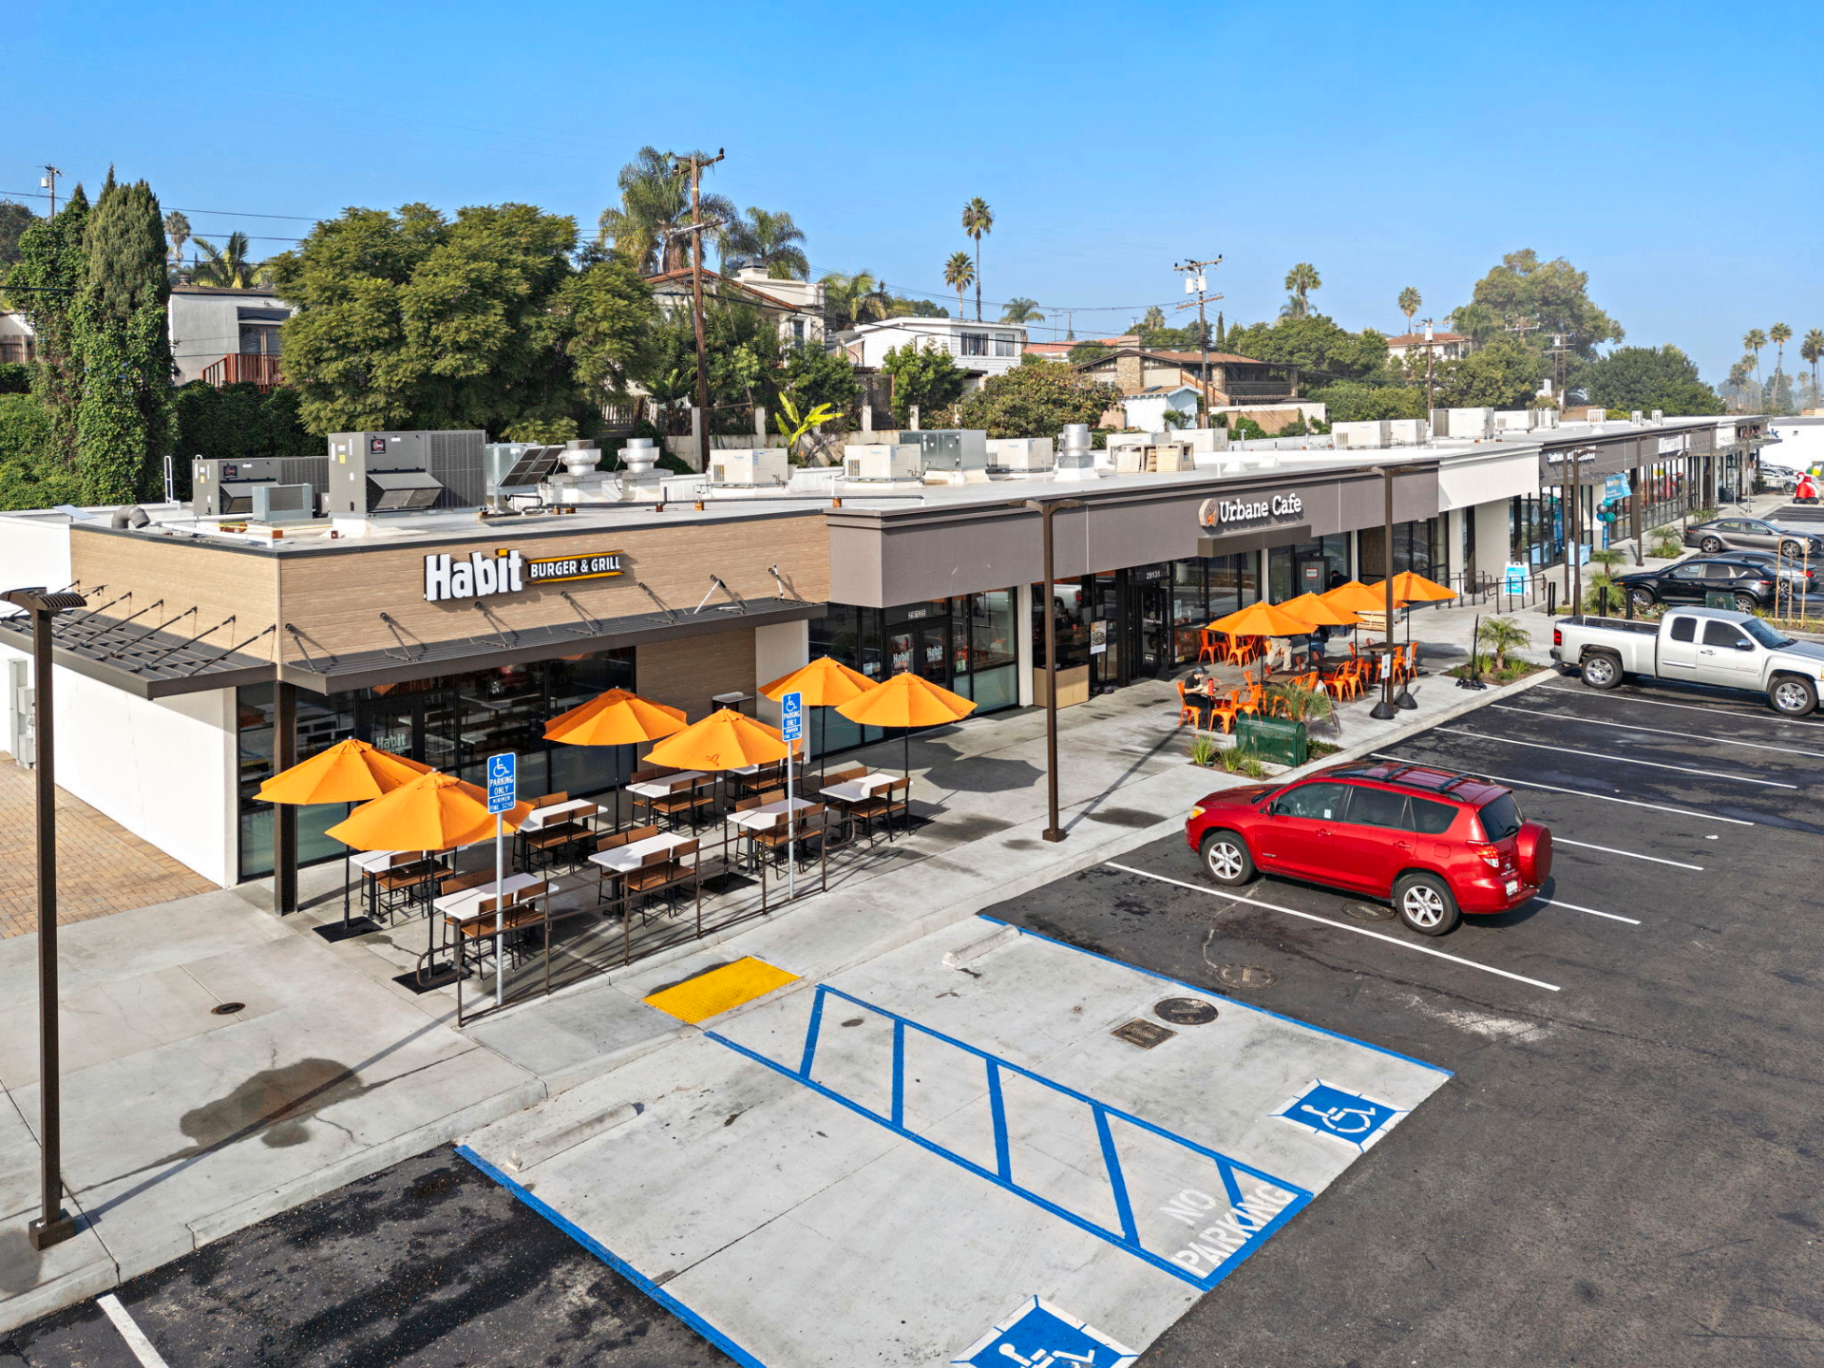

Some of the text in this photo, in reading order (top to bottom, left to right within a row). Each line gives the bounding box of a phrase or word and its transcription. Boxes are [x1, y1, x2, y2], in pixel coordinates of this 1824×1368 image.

[1219, 492, 1302, 522] Urbane Cafe
[425, 548, 522, 601] Habit
[530, 556, 620, 578] BURGER & GRILL
[376, 734, 406, 750] Habit
[490, 775, 514, 787] PARKING
[494, 785, 509, 796] ONLY
[1160, 1188, 1216, 1226] NO
[1170, 1184, 1300, 1279] PARKING
